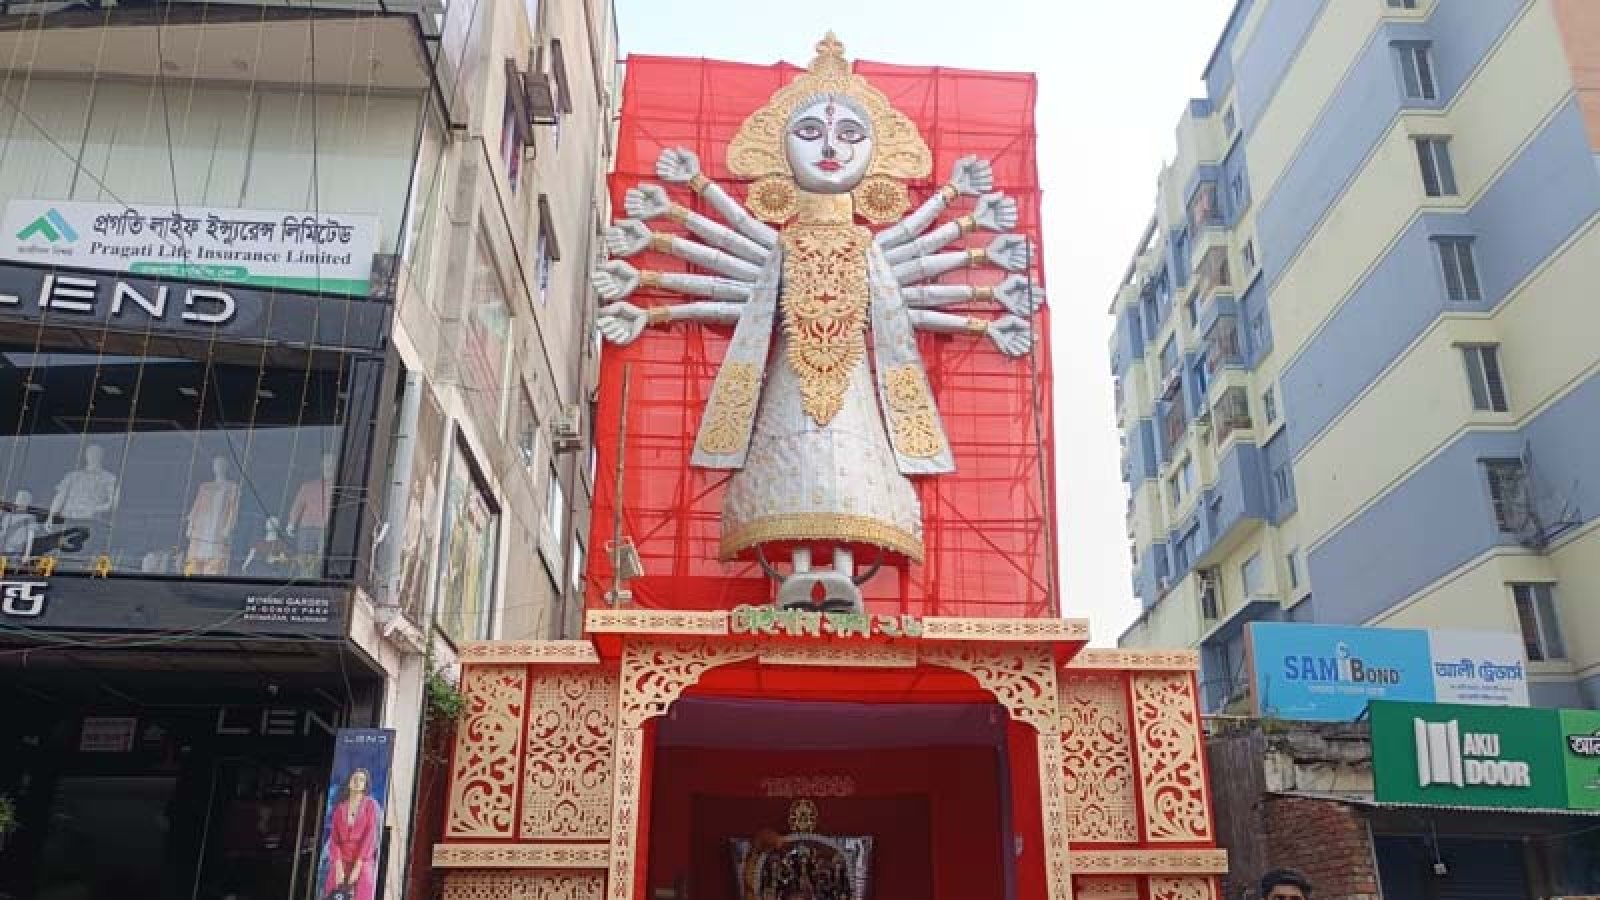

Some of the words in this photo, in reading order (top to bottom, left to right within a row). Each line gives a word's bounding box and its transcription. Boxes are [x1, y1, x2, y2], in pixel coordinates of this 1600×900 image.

[93, 207, 146, 236] প্রগতি
[149, 210, 202, 239] লাইফ
[281, 215, 354, 245] লিমিটেড
[89, 241, 152, 257] Pragati
[158, 243, 192, 258] Life
[197, 246, 280, 264] Insurance
[287, 250, 352, 266] Limited
[0, 274, 236, 323] END
[1284, 656, 1339, 682] SAM
[1463, 732, 1500, 757] AKU
[1463, 759, 1532, 787] DOOR
